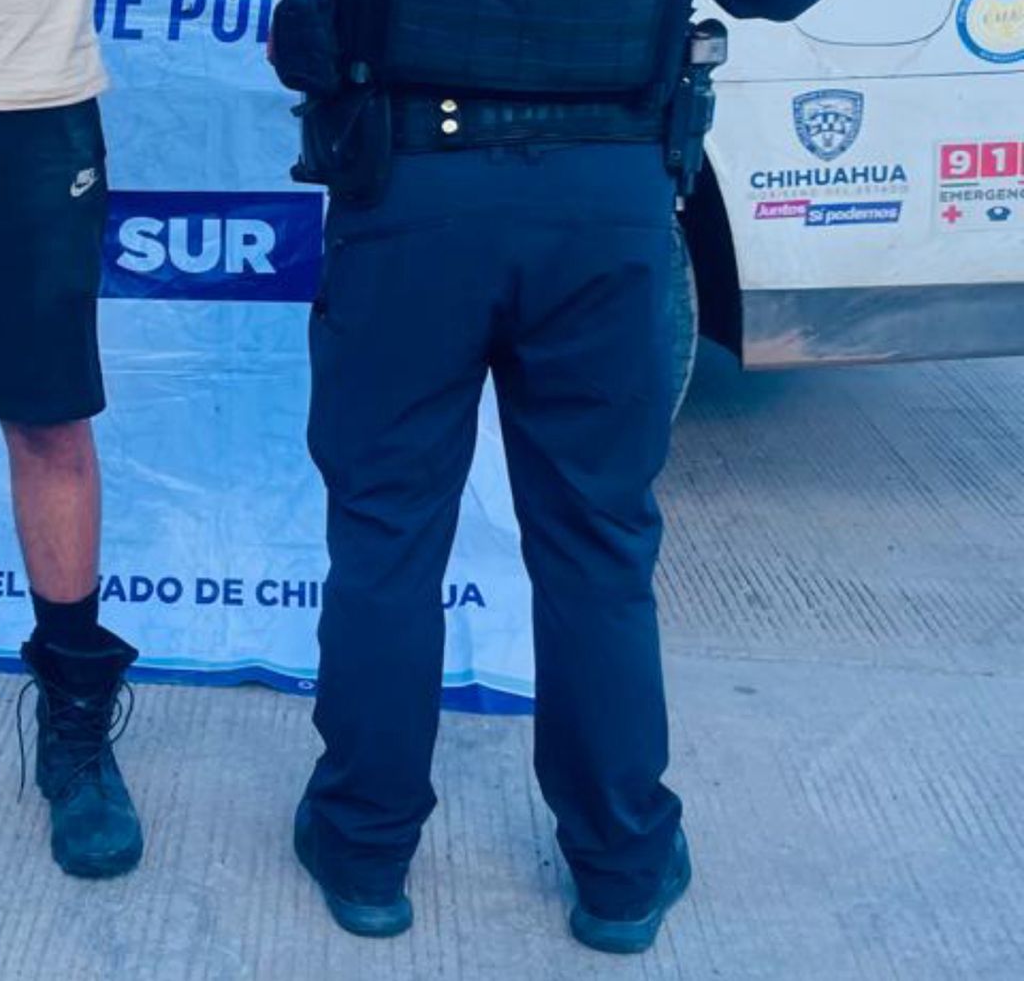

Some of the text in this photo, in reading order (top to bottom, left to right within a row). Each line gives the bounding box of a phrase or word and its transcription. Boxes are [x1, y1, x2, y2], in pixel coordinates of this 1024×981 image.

[749, 164, 908, 189] CHIHUAHUA
[116, 216, 276, 274] SUR
[98, 574, 184, 605] ADO
[194, 577, 244, 606] DE
